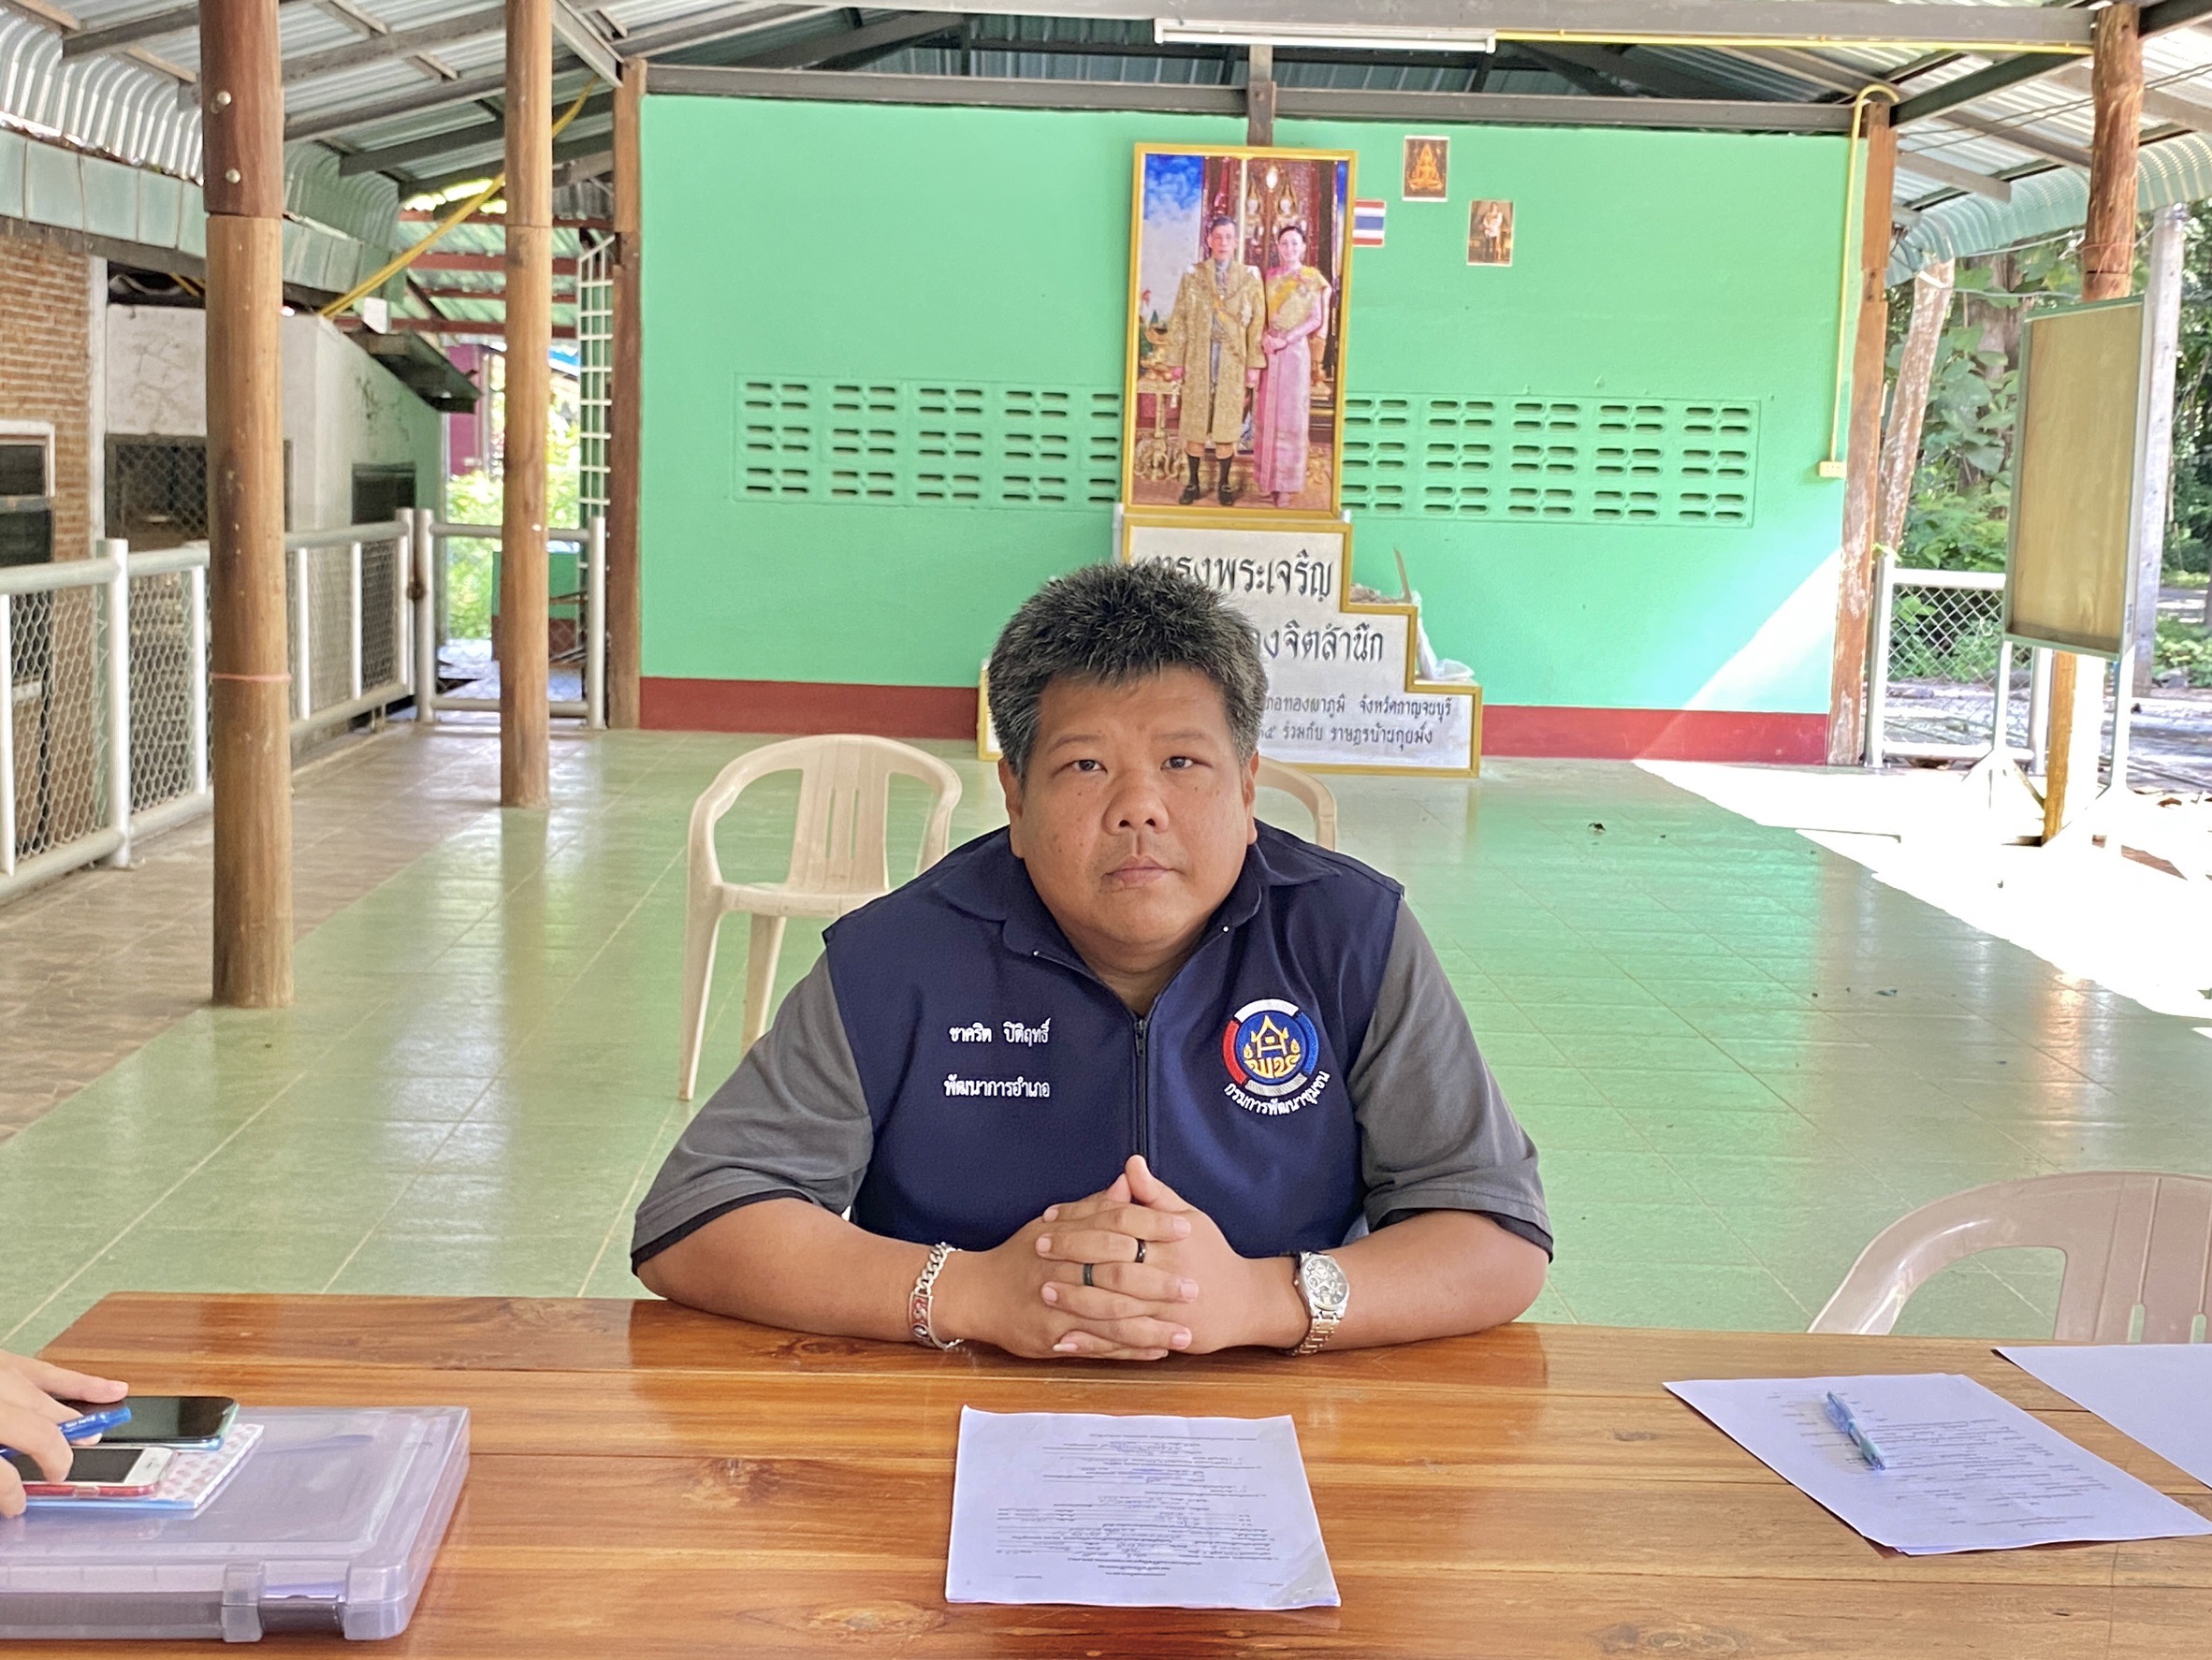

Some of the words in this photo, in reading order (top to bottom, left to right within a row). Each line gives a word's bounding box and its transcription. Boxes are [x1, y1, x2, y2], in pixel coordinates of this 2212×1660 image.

[1360, 694, 1453, 723] จังหวัดกาญจนบุรี
[1283, 720, 1324, 741] ร่วมกับ
[943, 1073, 1050, 1098] พัฒนาการอำเภอ
[1224, 1070, 1331, 1115] กรมการพัฒนาชุมชน
